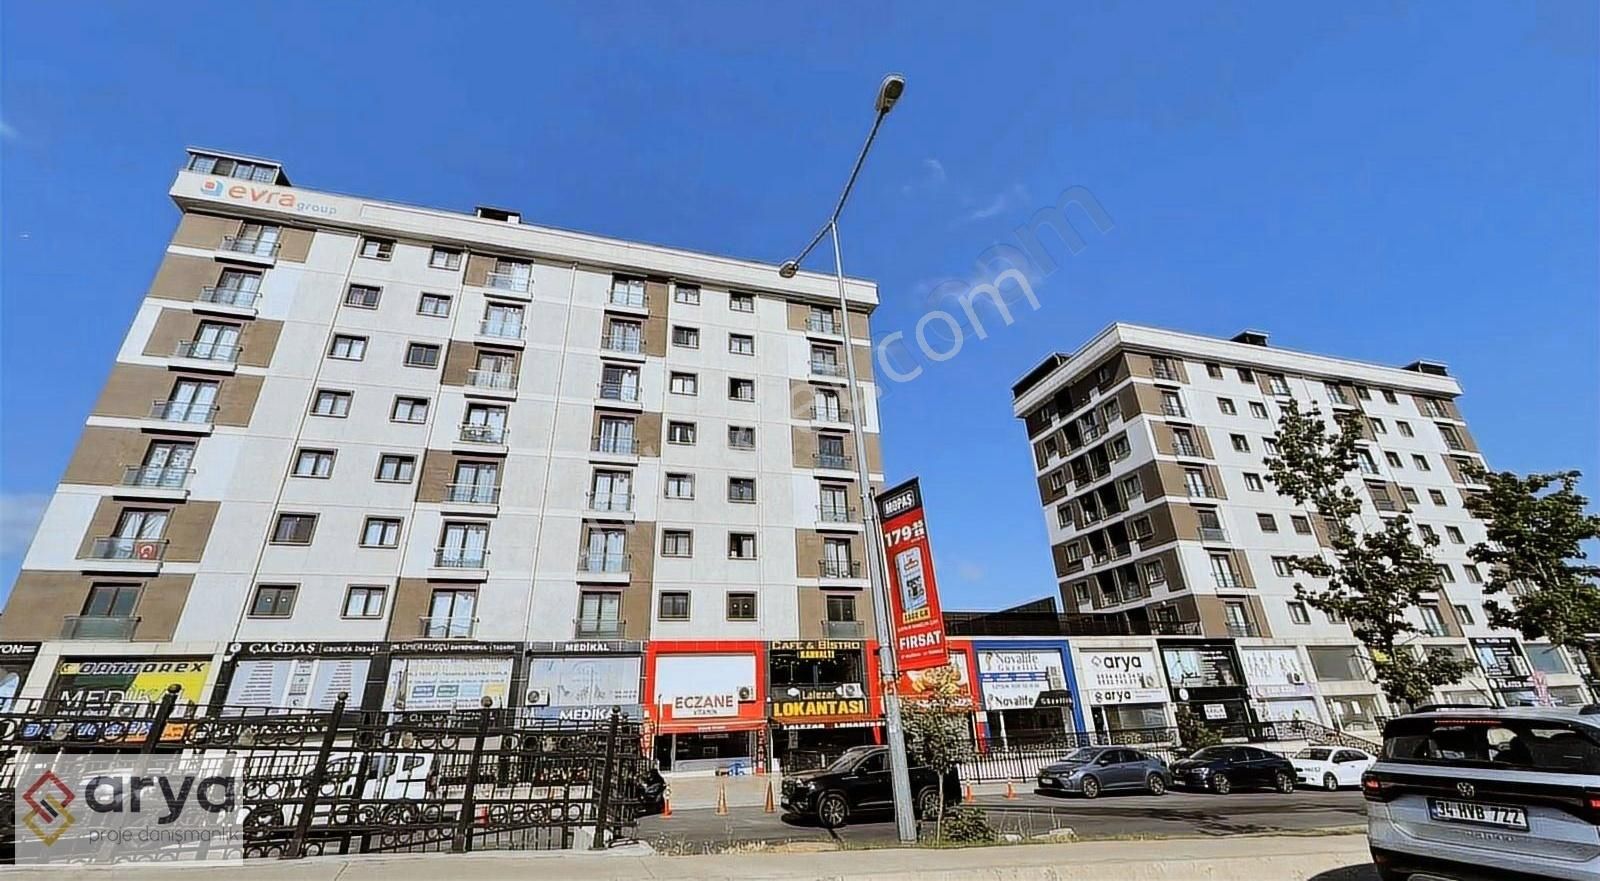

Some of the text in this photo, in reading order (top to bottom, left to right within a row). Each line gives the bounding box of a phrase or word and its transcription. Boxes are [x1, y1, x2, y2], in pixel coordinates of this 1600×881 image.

[228, 184, 337, 215] evra group
[565, 641, 610, 652] MEDİKAL
[806, 641, 814, 650] &
[900, 630, 942, 651] FIRSAT
[249, 642, 317, 655] ÇAĞDAŞ
[995, 651, 1039, 665] Novalife
[1103, 655, 1142, 672] arya
[675, 695, 733, 709] ECZANE
[994, 694, 1034, 706] Novalife
[1104, 691, 1131, 702] arya
[773, 700, 864, 717] LOKANTASI
[1437, 802, 1455, 817] 34
[1490, 807, 1522, 824] 722
